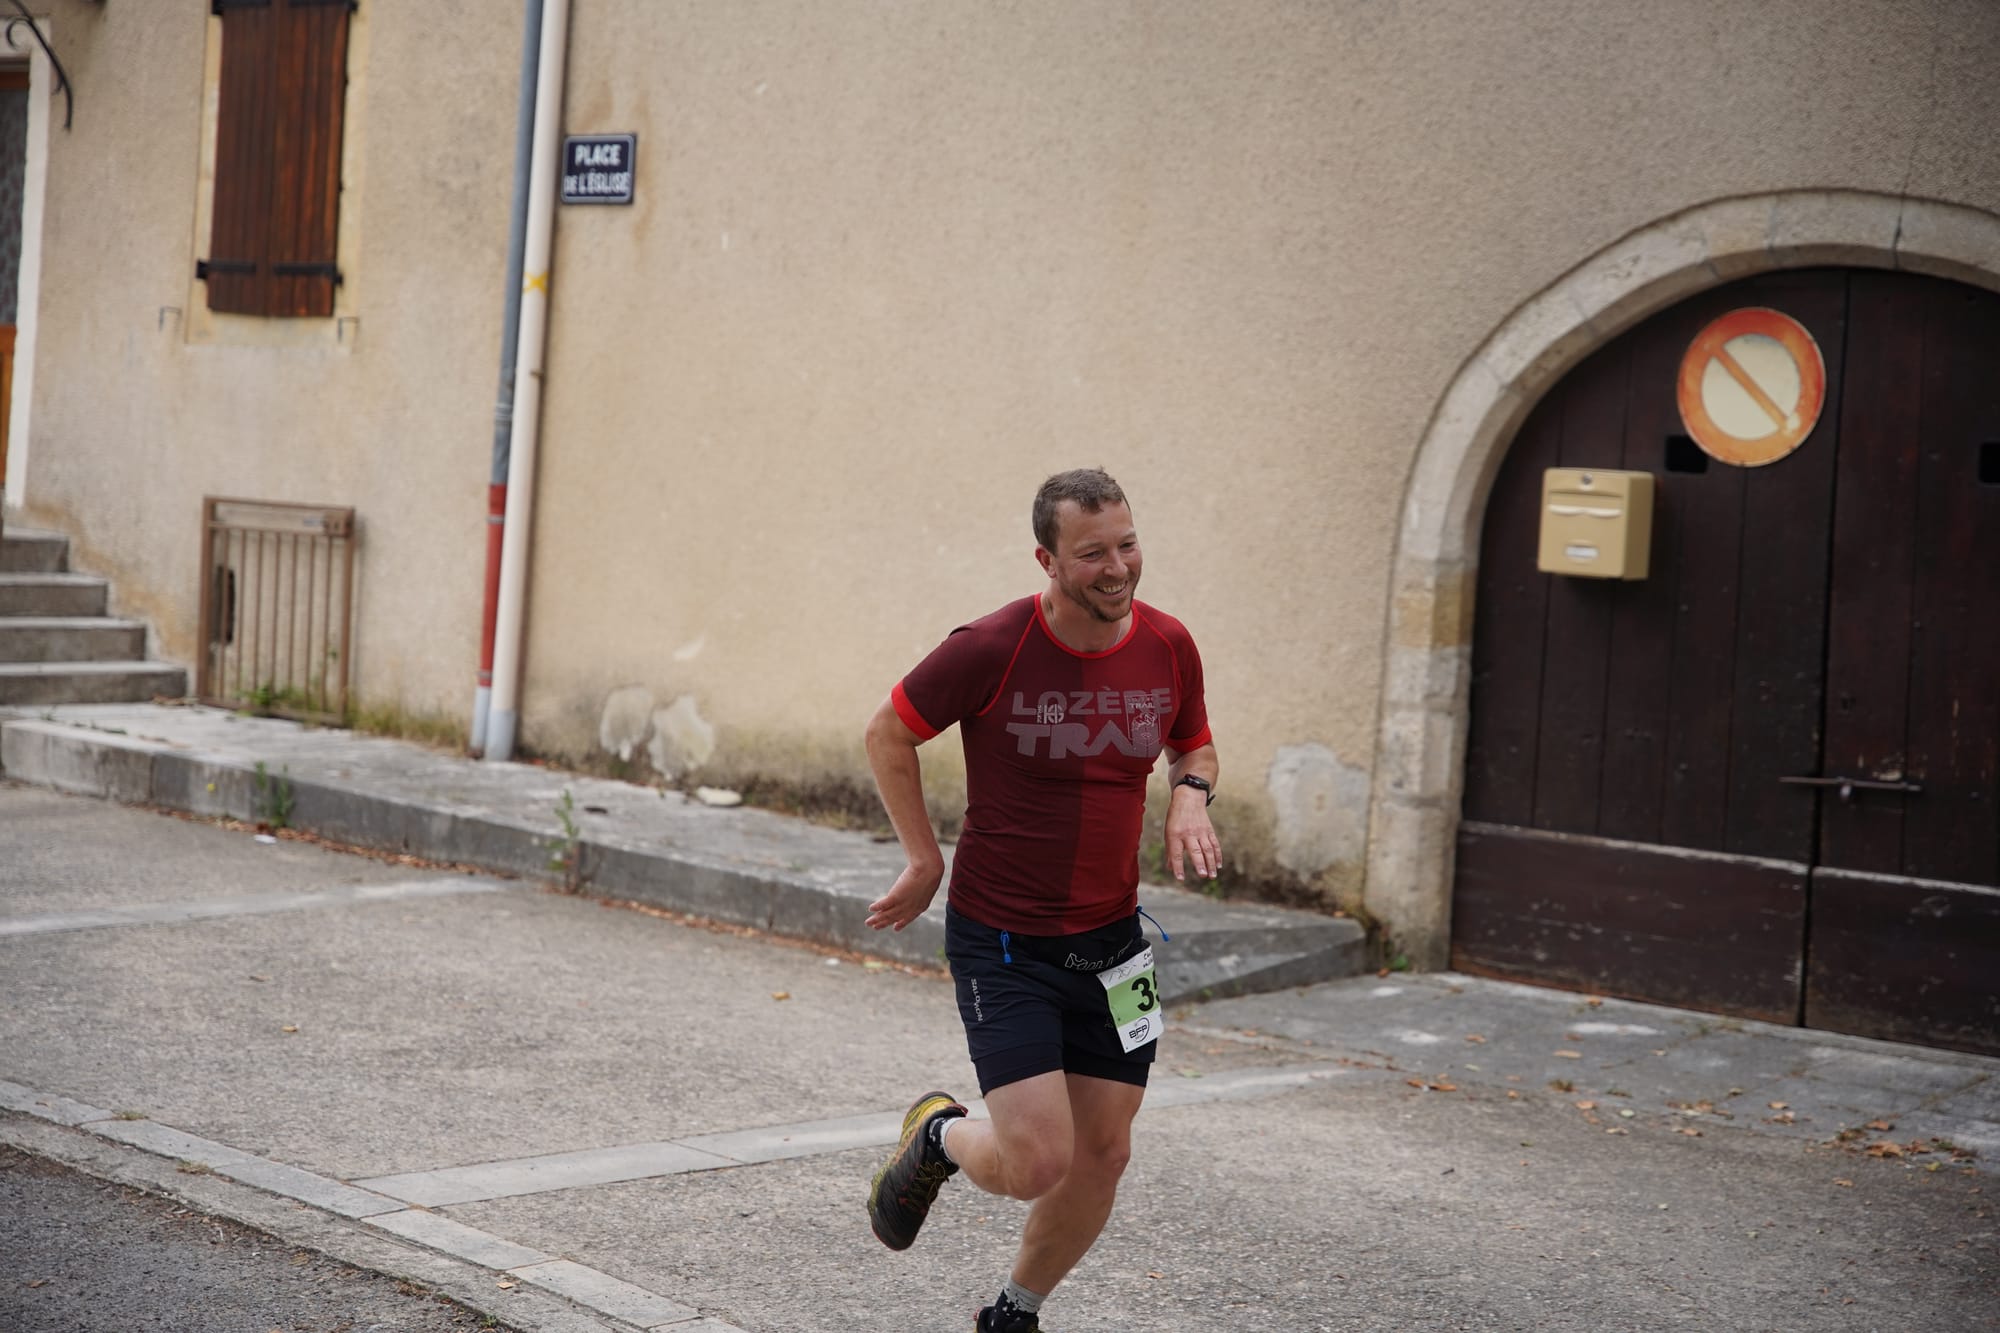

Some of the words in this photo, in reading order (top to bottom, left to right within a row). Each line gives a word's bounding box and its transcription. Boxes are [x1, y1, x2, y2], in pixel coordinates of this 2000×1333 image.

[574, 144, 621, 166] PLACE
[564, 175, 577, 194] DE
[1012, 686, 1173, 716] LOZÈRE
[970, 978, 984, 1022] SALOMON
